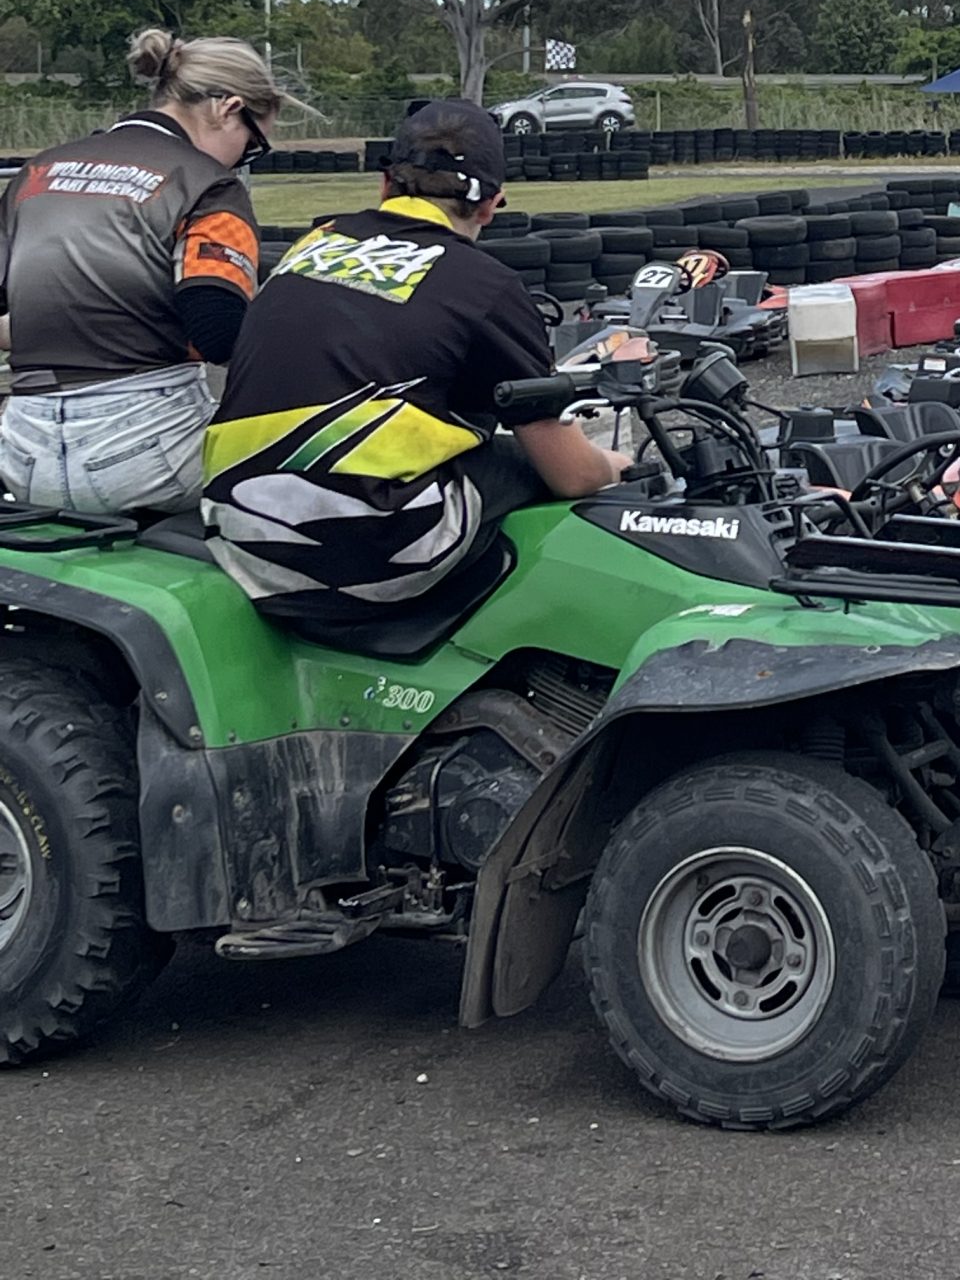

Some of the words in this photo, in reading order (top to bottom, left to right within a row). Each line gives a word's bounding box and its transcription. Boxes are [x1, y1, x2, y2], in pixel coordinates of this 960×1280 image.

[46, 161, 164, 191] WOLLONGONG
[48, 177, 88, 191] KART
[84, 179, 153, 204] RACEWAY
[639, 269, 673, 285] 27
[620, 509, 740, 540] Kawasaki
[383, 684, 435, 714] 300
